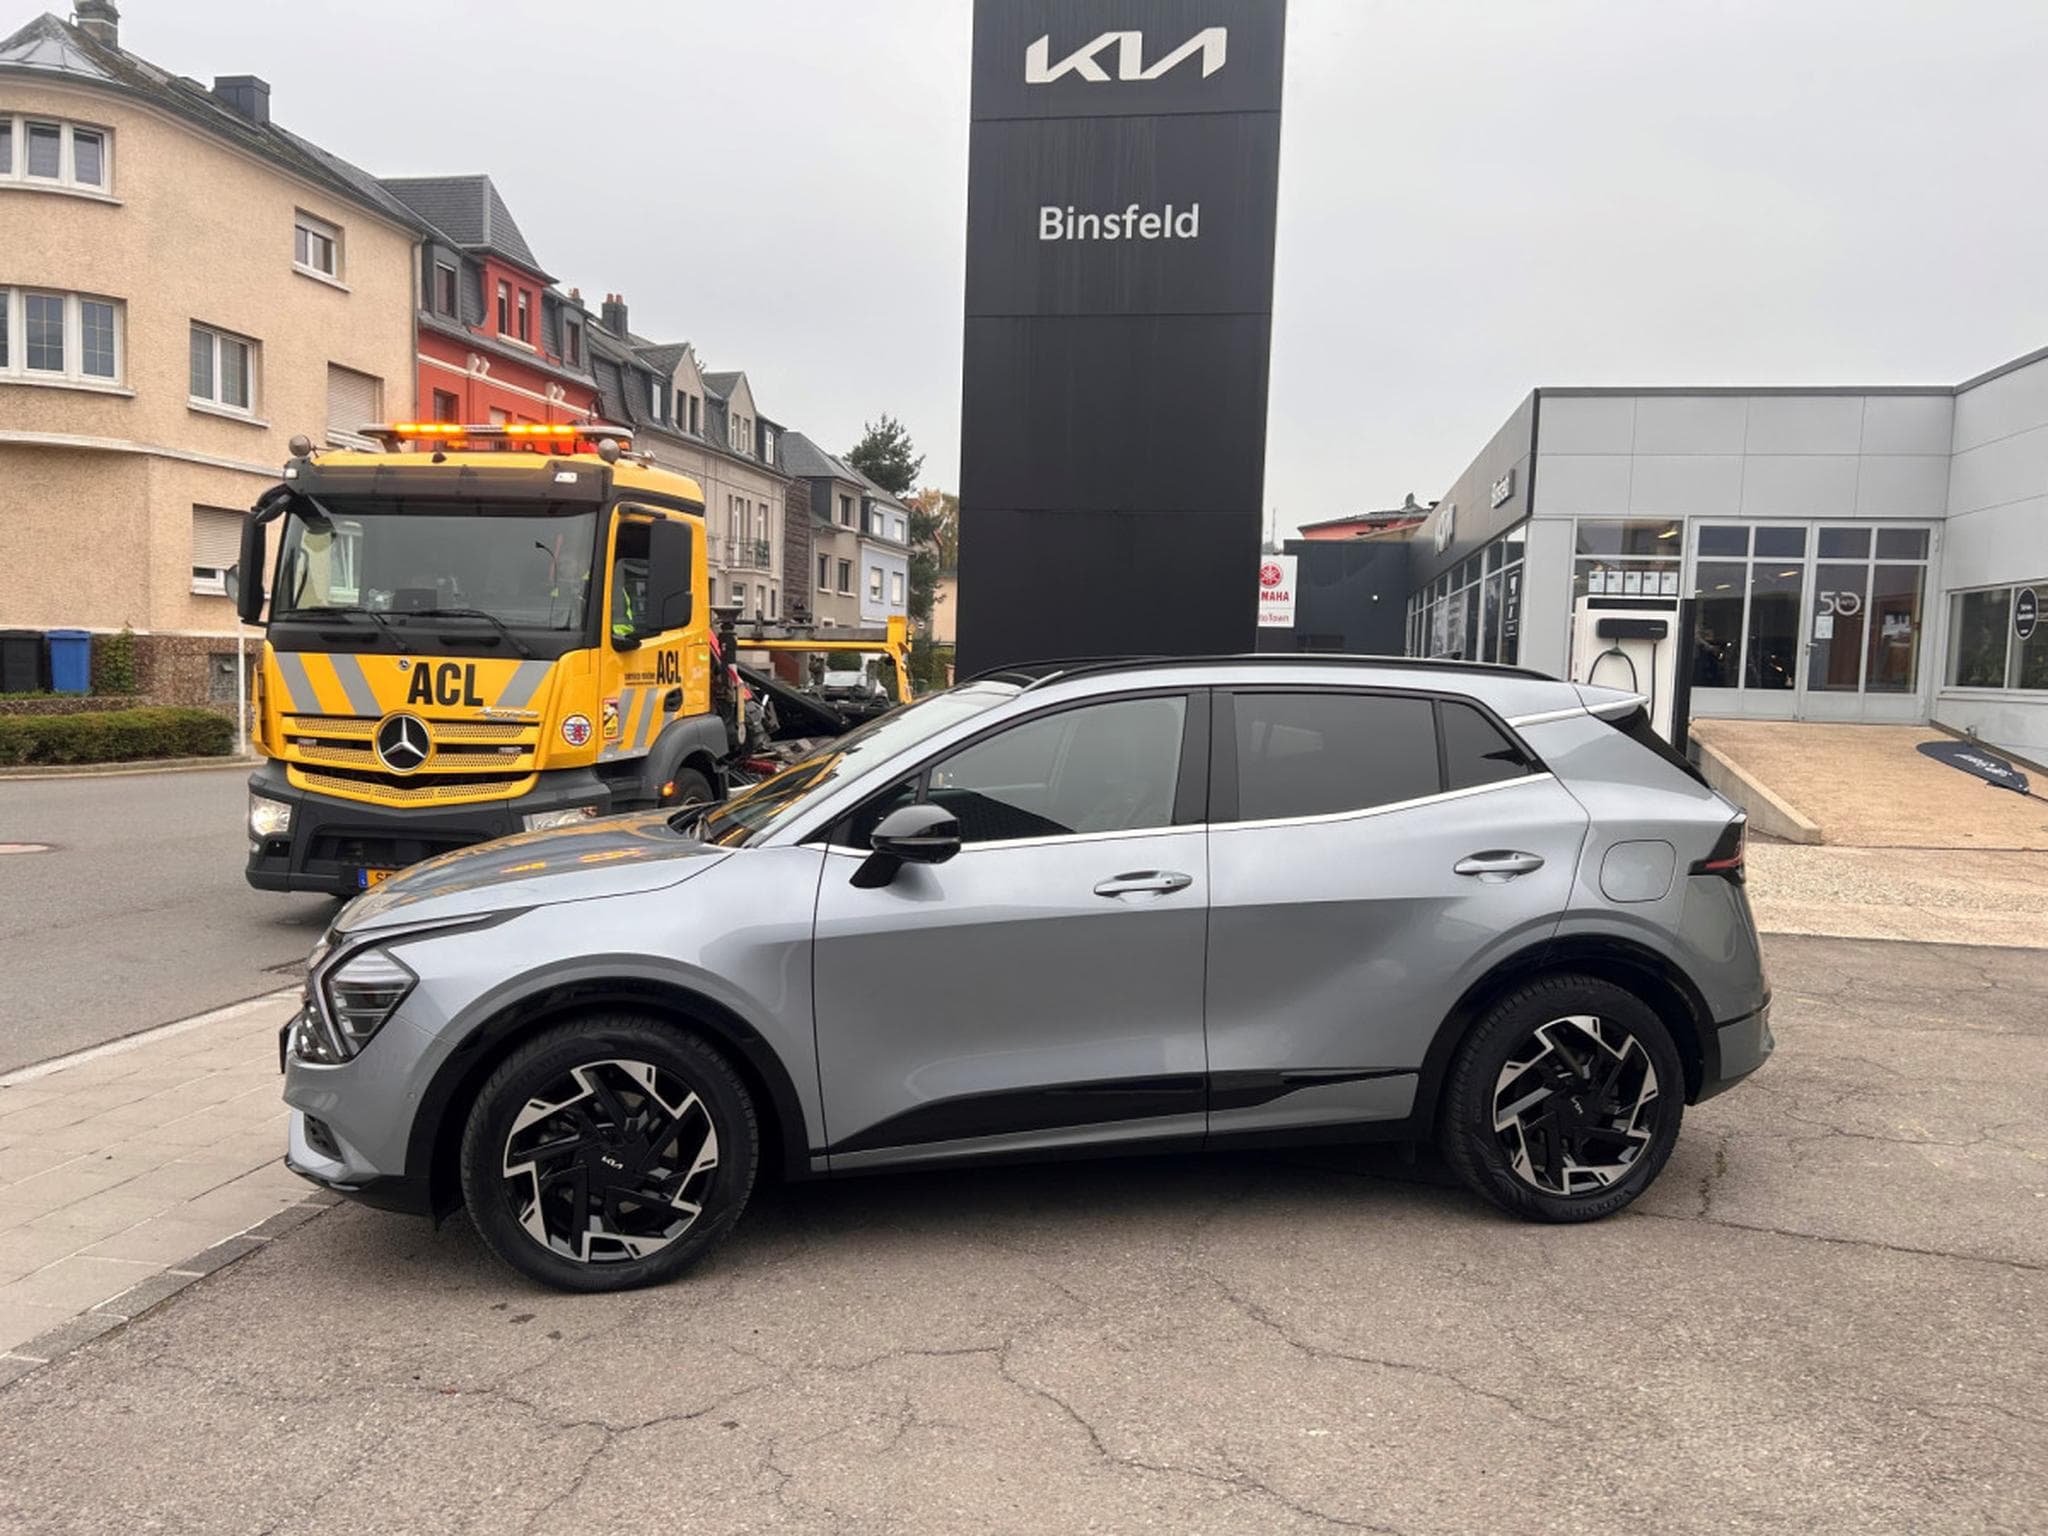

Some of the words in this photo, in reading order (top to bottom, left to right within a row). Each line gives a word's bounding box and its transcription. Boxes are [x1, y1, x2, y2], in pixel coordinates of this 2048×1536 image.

[1025, 27, 1227, 83] KIA
[1039, 203, 1200, 240] Binsfeld
[1261, 591, 1290, 602] MAHA
[407, 662, 484, 706] ACL
[657, 650, 682, 685] ACL
